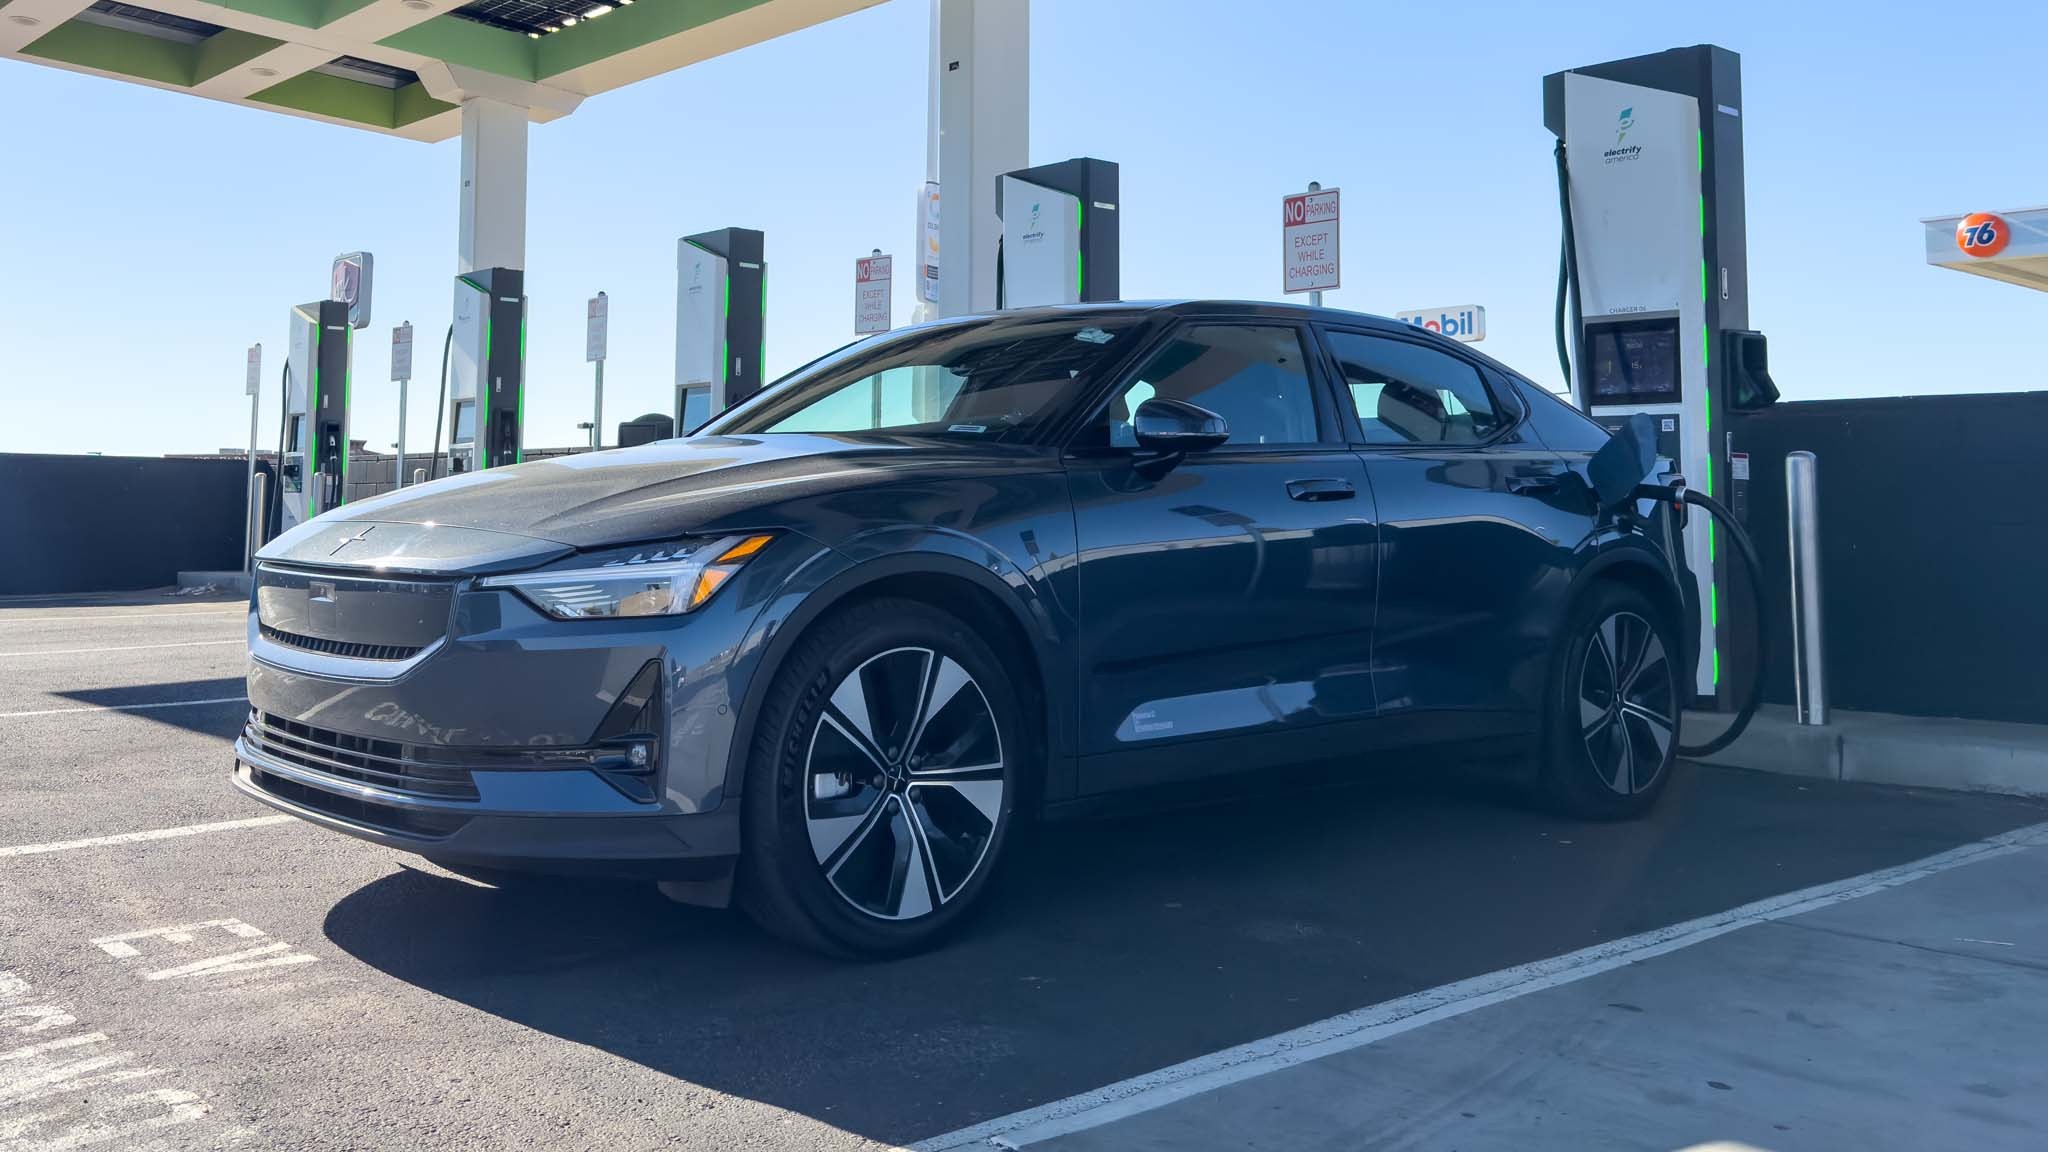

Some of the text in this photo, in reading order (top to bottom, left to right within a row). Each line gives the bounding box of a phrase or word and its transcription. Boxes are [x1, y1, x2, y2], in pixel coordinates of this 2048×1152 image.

[1604, 145, 1642, 157] electrify
[1605, 154, 1639, 165] america
[1285, 201, 1336, 223] NO PARKING
[1294, 233, 1328, 248] EXCEPT
[1964, 222, 1996, 248] 76
[1298, 249, 1325, 262] WHILE
[857, 262, 869, 280] NO
[1288, 263, 1335, 279] CHARGING
[90, 917, 320, 981] EV
